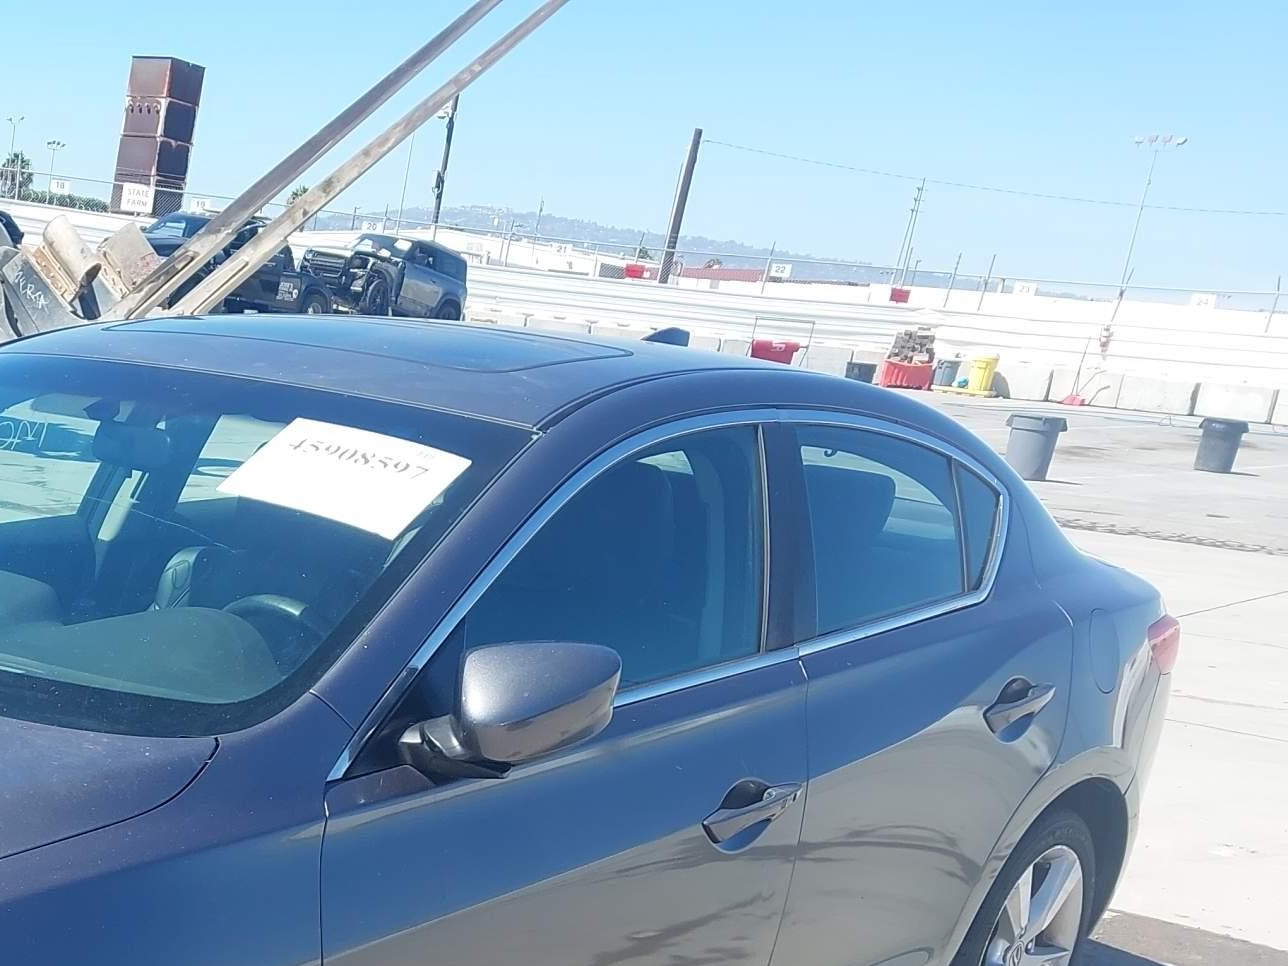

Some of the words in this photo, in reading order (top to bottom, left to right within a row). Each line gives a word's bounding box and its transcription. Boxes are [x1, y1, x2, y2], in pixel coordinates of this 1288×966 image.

[127, 188, 150, 198] STATE
[126, 197, 148, 208] FARM
[366, 222, 378, 231] 20
[774, 265, 786, 274] 22
[287, 436, 430, 480] 45908597
